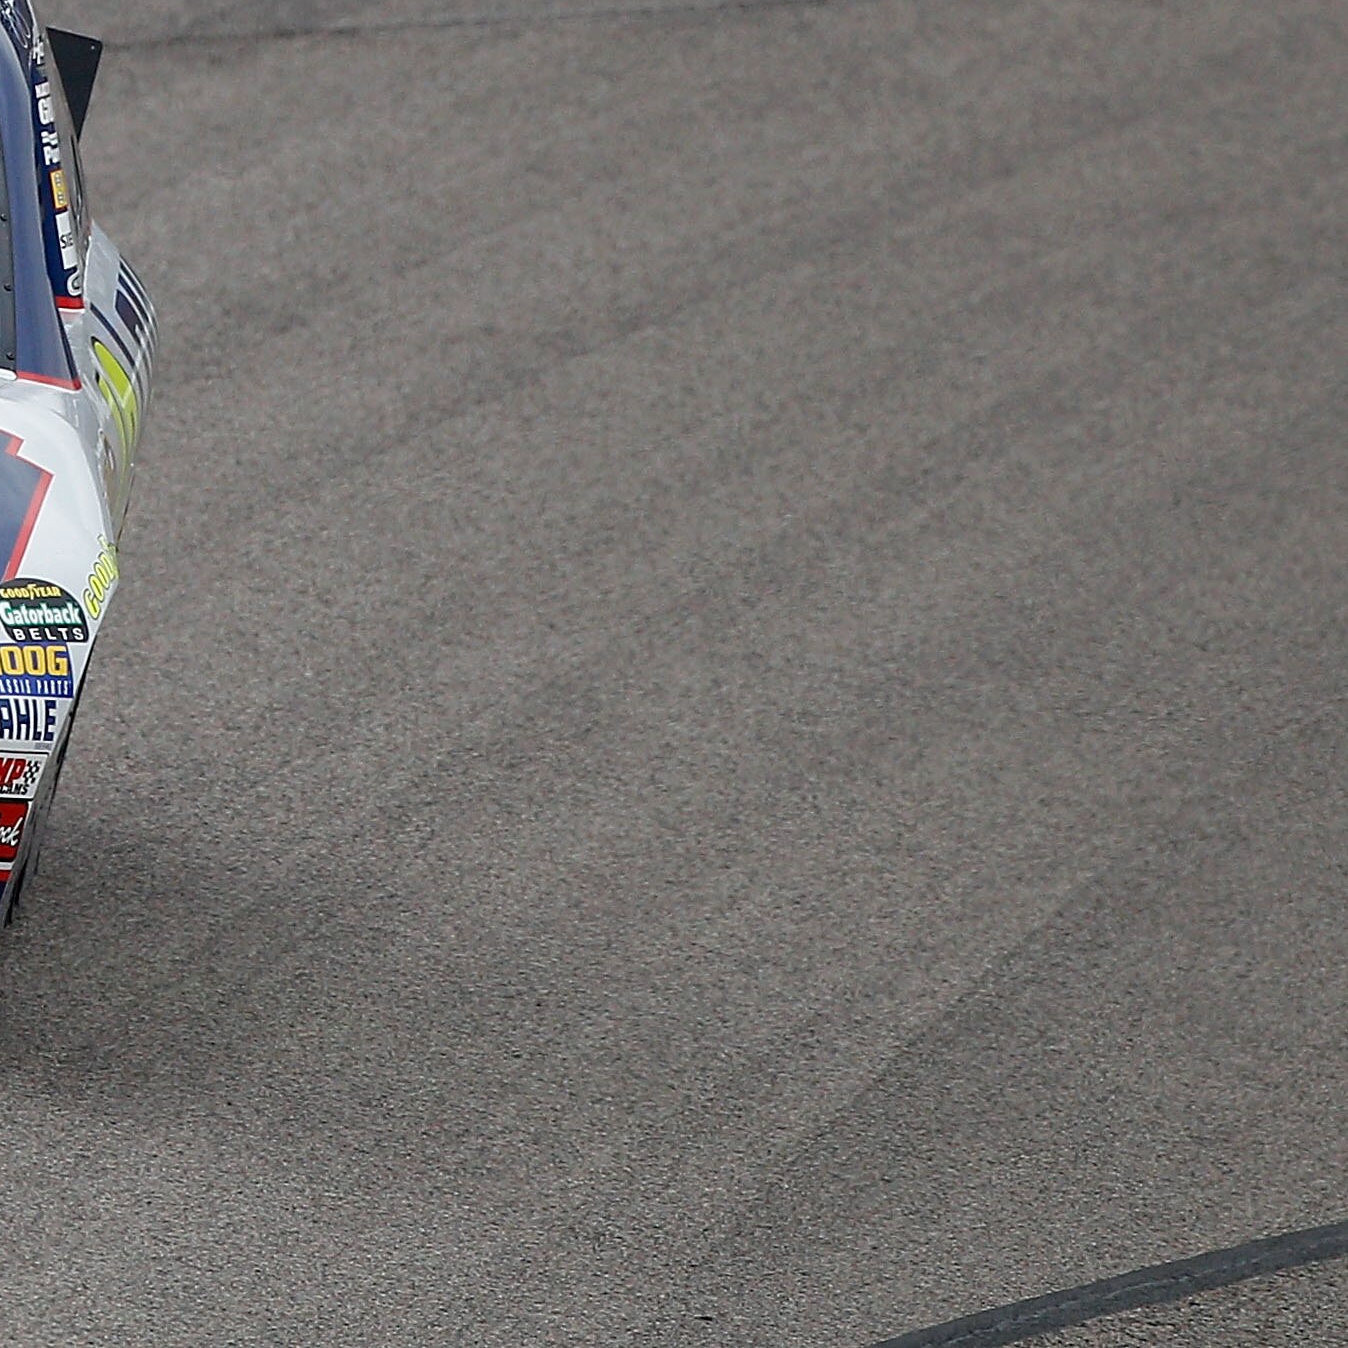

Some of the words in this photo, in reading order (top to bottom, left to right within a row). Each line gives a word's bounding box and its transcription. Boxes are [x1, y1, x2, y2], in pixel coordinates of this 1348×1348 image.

[12, 627, 84, 641] BELTS
[36, 679, 69, 696] PARTS
[0, 783, 30, 796] CAMS
